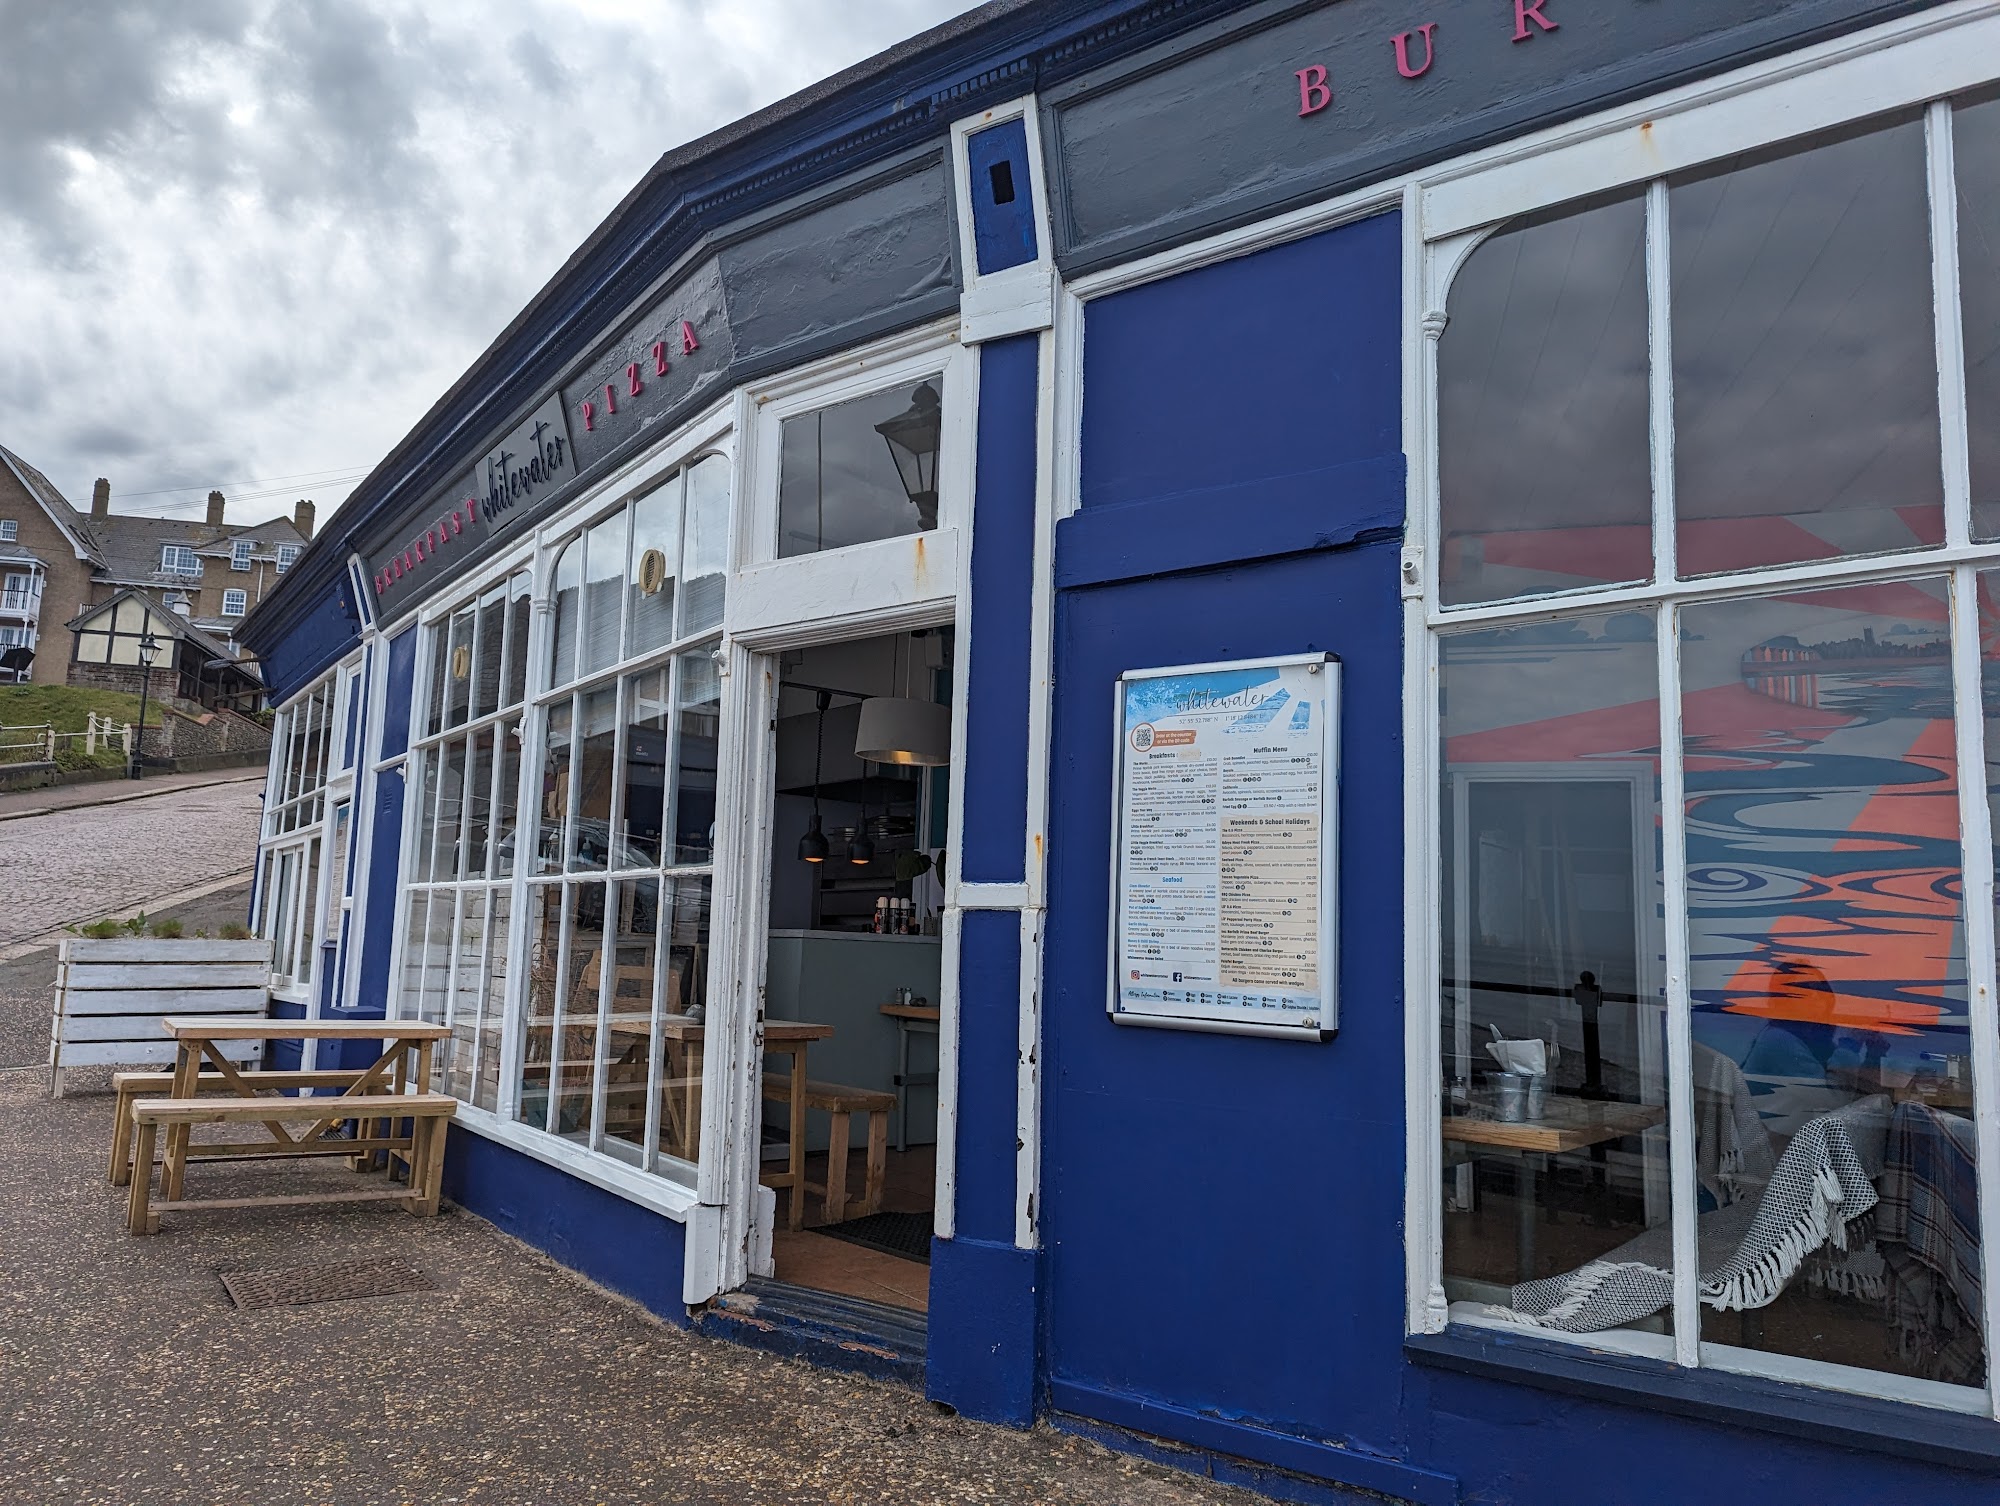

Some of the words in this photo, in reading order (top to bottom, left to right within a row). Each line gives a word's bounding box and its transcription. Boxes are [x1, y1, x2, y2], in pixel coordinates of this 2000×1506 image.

[1294, 0, 1560, 117] BUR
[582, 320, 699, 431] PIZZA
[481, 420, 566, 523] whitewater
[374, 498, 477, 595] BREAKFAST
[1175, 685, 1269, 712] whitewater
[1285, 818, 1310, 826] Holidays
